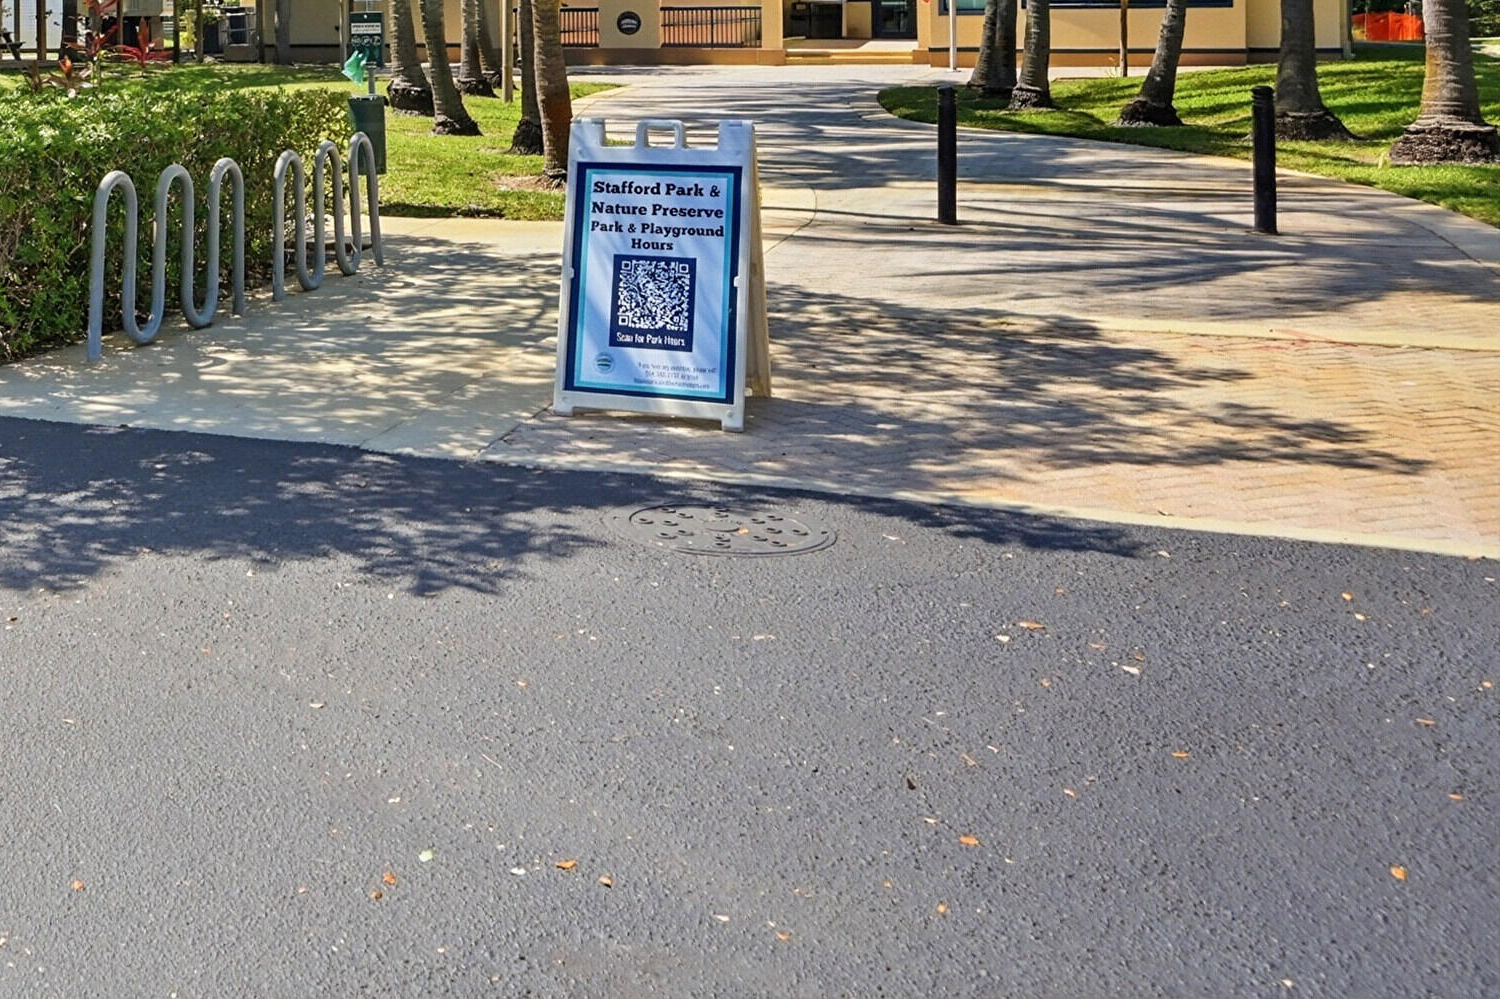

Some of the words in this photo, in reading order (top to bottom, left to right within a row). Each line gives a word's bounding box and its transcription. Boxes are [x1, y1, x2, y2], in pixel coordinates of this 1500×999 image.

[593, 181, 661, 195] Stafford
[665, 183, 704, 197] Park
[709, 185, 721, 198] &
[591, 201, 648, 216] Nature
[651, 204, 724, 219] Preserve
[590, 220, 623, 233] Park
[627, 223, 637, 234] &
[640, 222, 725, 238] Playground
[631, 238, 674, 251] Hours
[616, 332, 633, 342] Scan
[634, 334, 645, 343] for
[646, 334, 662, 345] Park
[664, 336, 685, 346] Hours
